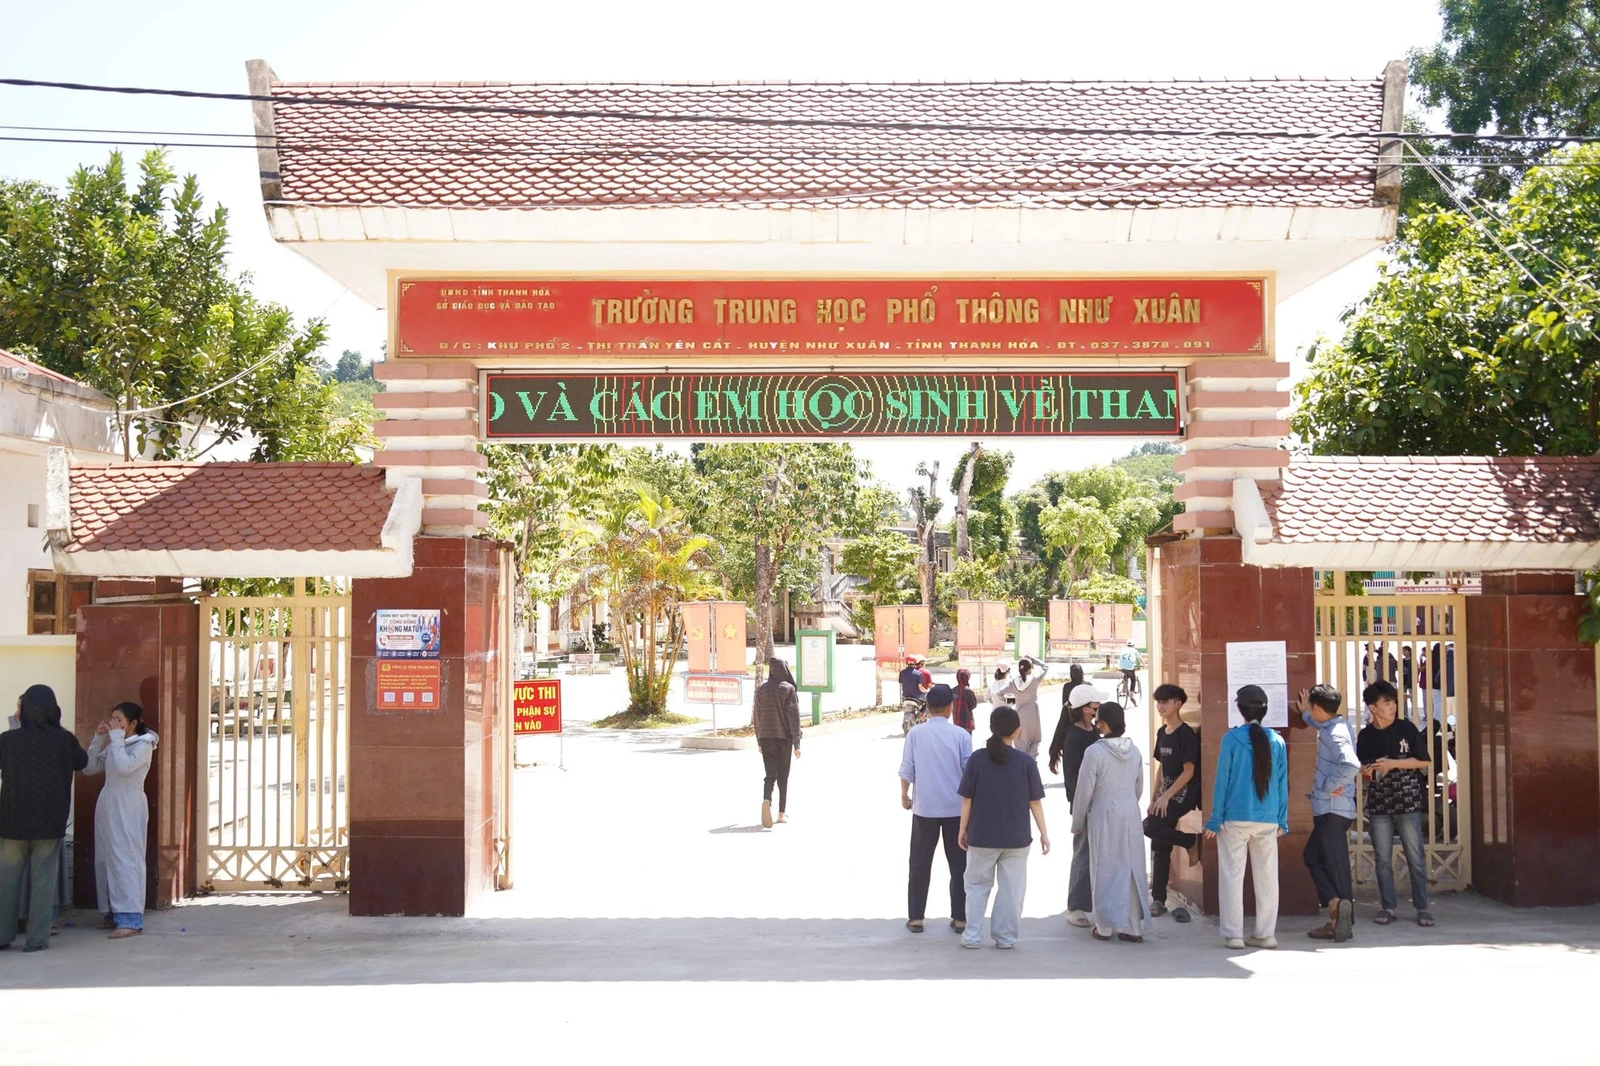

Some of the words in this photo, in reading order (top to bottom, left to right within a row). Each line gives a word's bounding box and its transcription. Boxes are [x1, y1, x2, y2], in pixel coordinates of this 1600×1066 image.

[452, 300, 474, 309] GIÁO
[592, 289, 694, 324] TRƯỜNG
[713, 298, 797, 324] TRUNG
[816, 298, 867, 331] HỌC
[886, 285, 938, 324] PHỔ
[955, 291, 1040, 324] THÔNG
[1059, 296, 1114, 324] NHƯ
[1133, 292, 1201, 324] XUÂN
[524, 337, 556, 349] PHỐ
[587, 342, 612, 352] THỊ
[665, 340, 696, 349] YÊN
[748, 340, 800, 352] HUYỆN
[806, 341, 840, 349] NHƯ
[845, 339, 890, 349] XUÂN
[949, 341, 1002, 349] THANH
[1008, 338, 1039, 349] HÓA
[516, 381, 579, 421] VÀ
[589, 381, 682, 421] CÁC
[694, 389, 763, 420] EM
[776, 389, 874, 429] HỌC
[885, 389, 988, 420] SINH
[999, 379, 1059, 420] VỀ
[537, 686, 556, 700] THI
[516, 705, 541, 718] PHẬN
[543, 705, 557, 717] SỰ
[524, 719, 542, 731] VÀO
